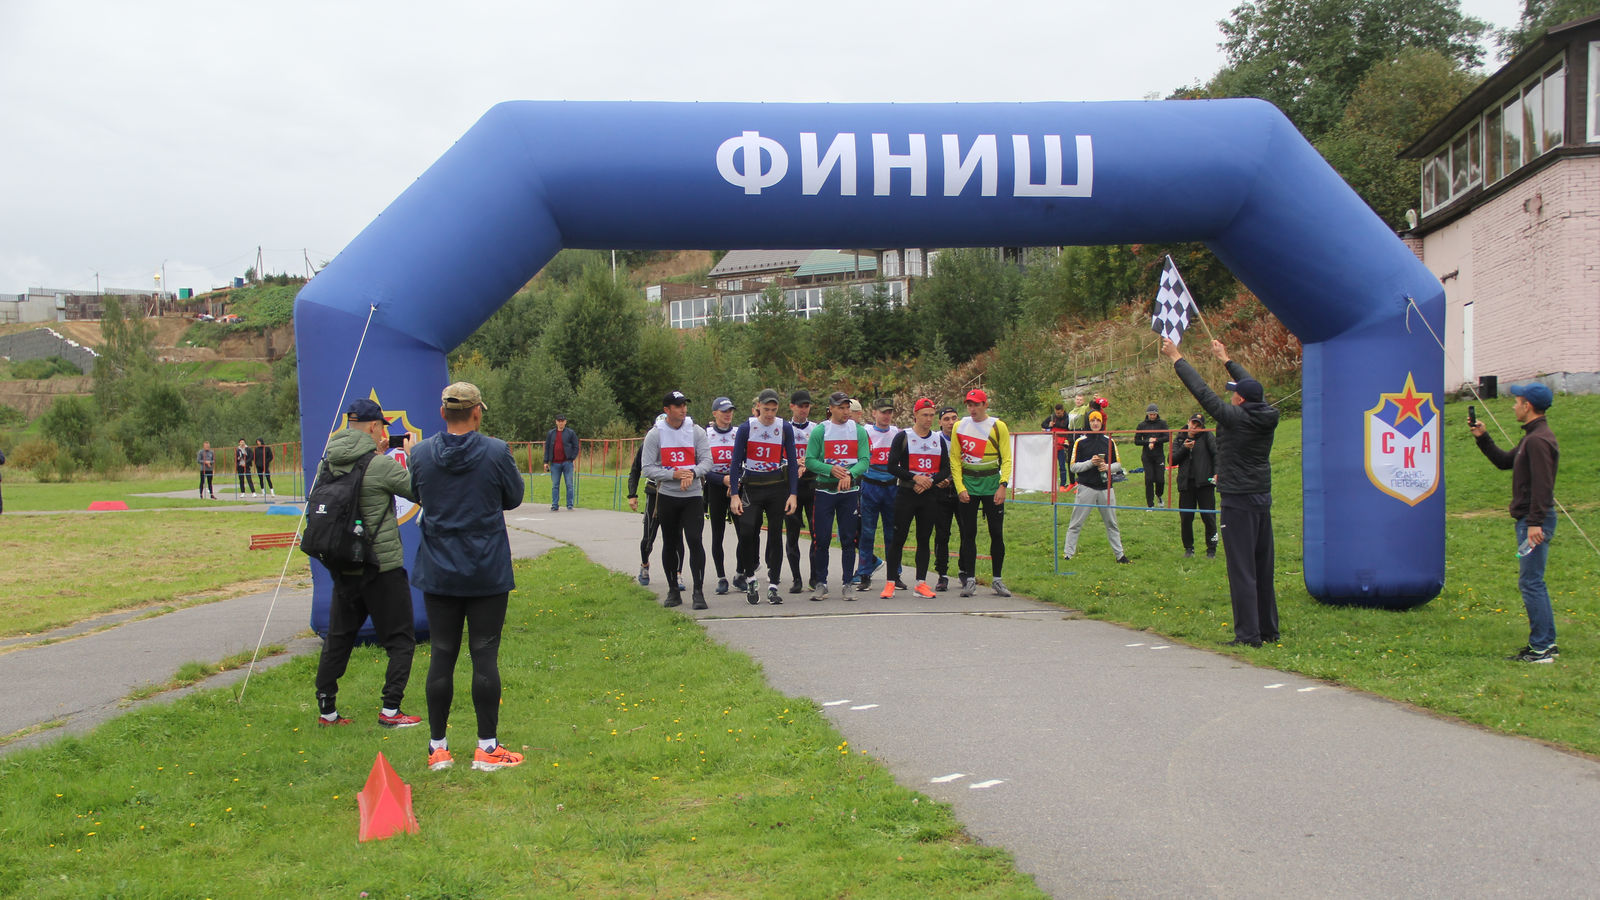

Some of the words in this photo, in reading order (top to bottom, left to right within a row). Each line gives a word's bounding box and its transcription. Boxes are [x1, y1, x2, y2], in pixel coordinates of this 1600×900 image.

[716, 131, 1093, 197] ФИНИШ
[834, 444, 849, 455] 32
[962, 439, 976, 452] 29
[670, 451, 685, 462] 33
[718, 449, 732, 460] 28
[756, 446, 771, 458] 31
[918, 458, 932, 469] 38
